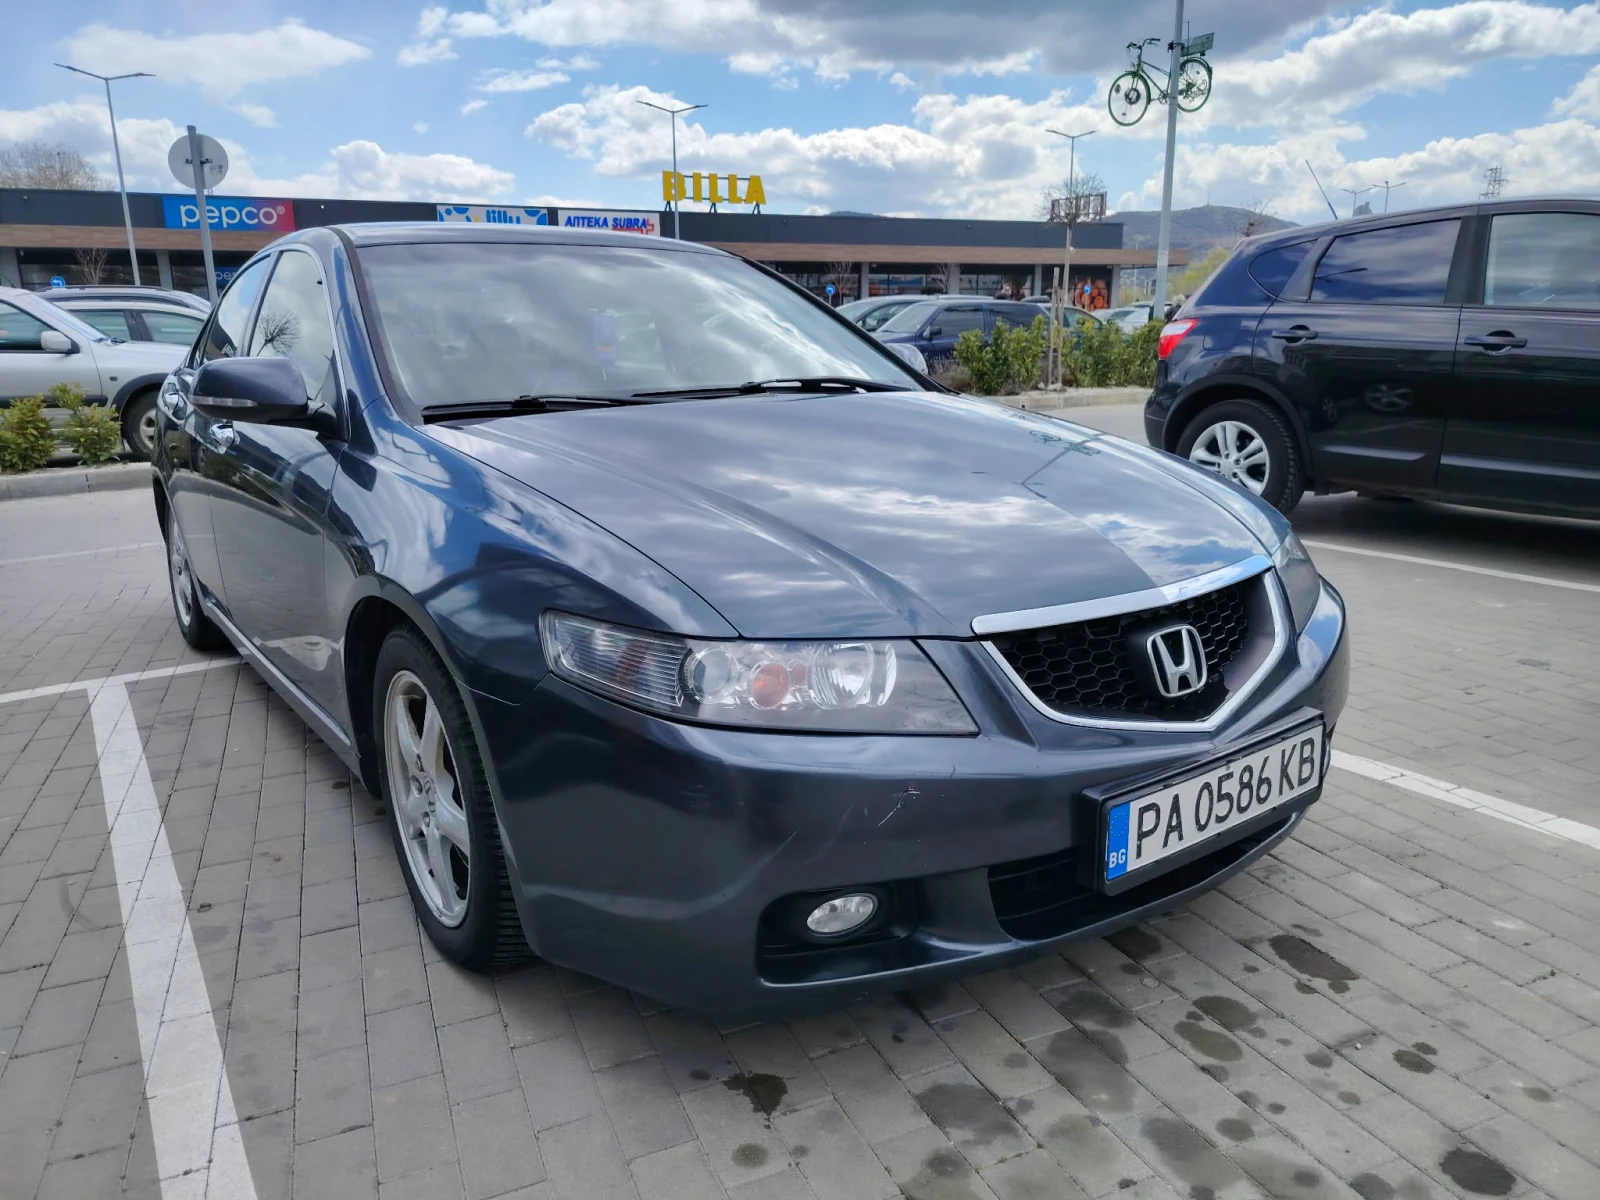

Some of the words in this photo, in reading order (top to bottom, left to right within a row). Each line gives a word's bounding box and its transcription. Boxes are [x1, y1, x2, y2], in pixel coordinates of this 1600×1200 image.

[662, 170, 767, 205] BILLA
[565, 215, 609, 229] АПТЕКА
[612, 217, 647, 230] SUBRA
[1135, 793, 1184, 860] PA
[1194, 755, 1272, 832] 0586
[1278, 737, 1315, 798] KB
[1109, 848, 1126, 868] BG
